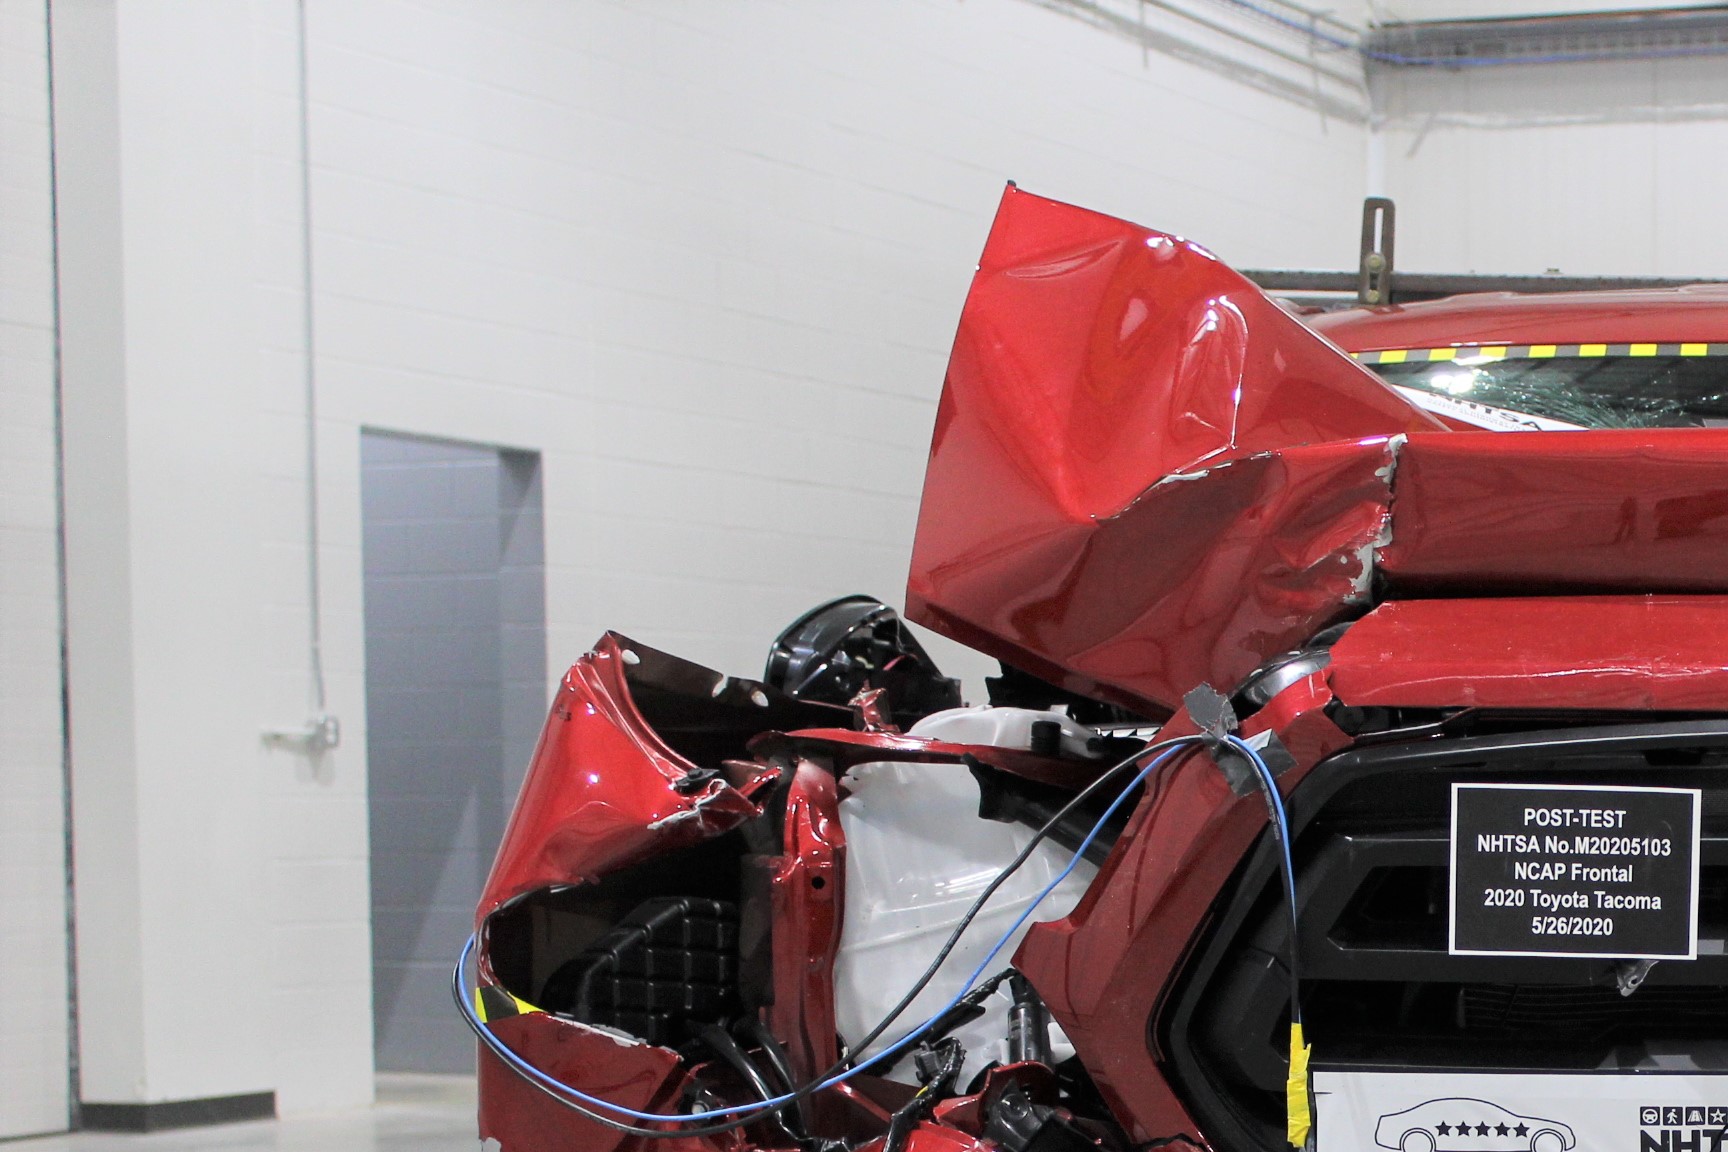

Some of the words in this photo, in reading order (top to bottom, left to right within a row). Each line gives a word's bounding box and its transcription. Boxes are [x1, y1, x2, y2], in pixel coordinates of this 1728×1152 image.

[1524, 808, 1626, 828] POST-TEST
[1477, 834, 1541, 853] NHTSA
[1545, 836, 1671, 856] No.M20205103
[1514, 862, 1566, 881] NCAP
[1571, 864, 1633, 882] Frontal
[1484, 889, 1524, 907] 2020
[1530, 890, 1589, 912] Toyota
[1594, 891, 1662, 909] Tacoma
[1531, 917, 1613, 935] 5/26/2020
